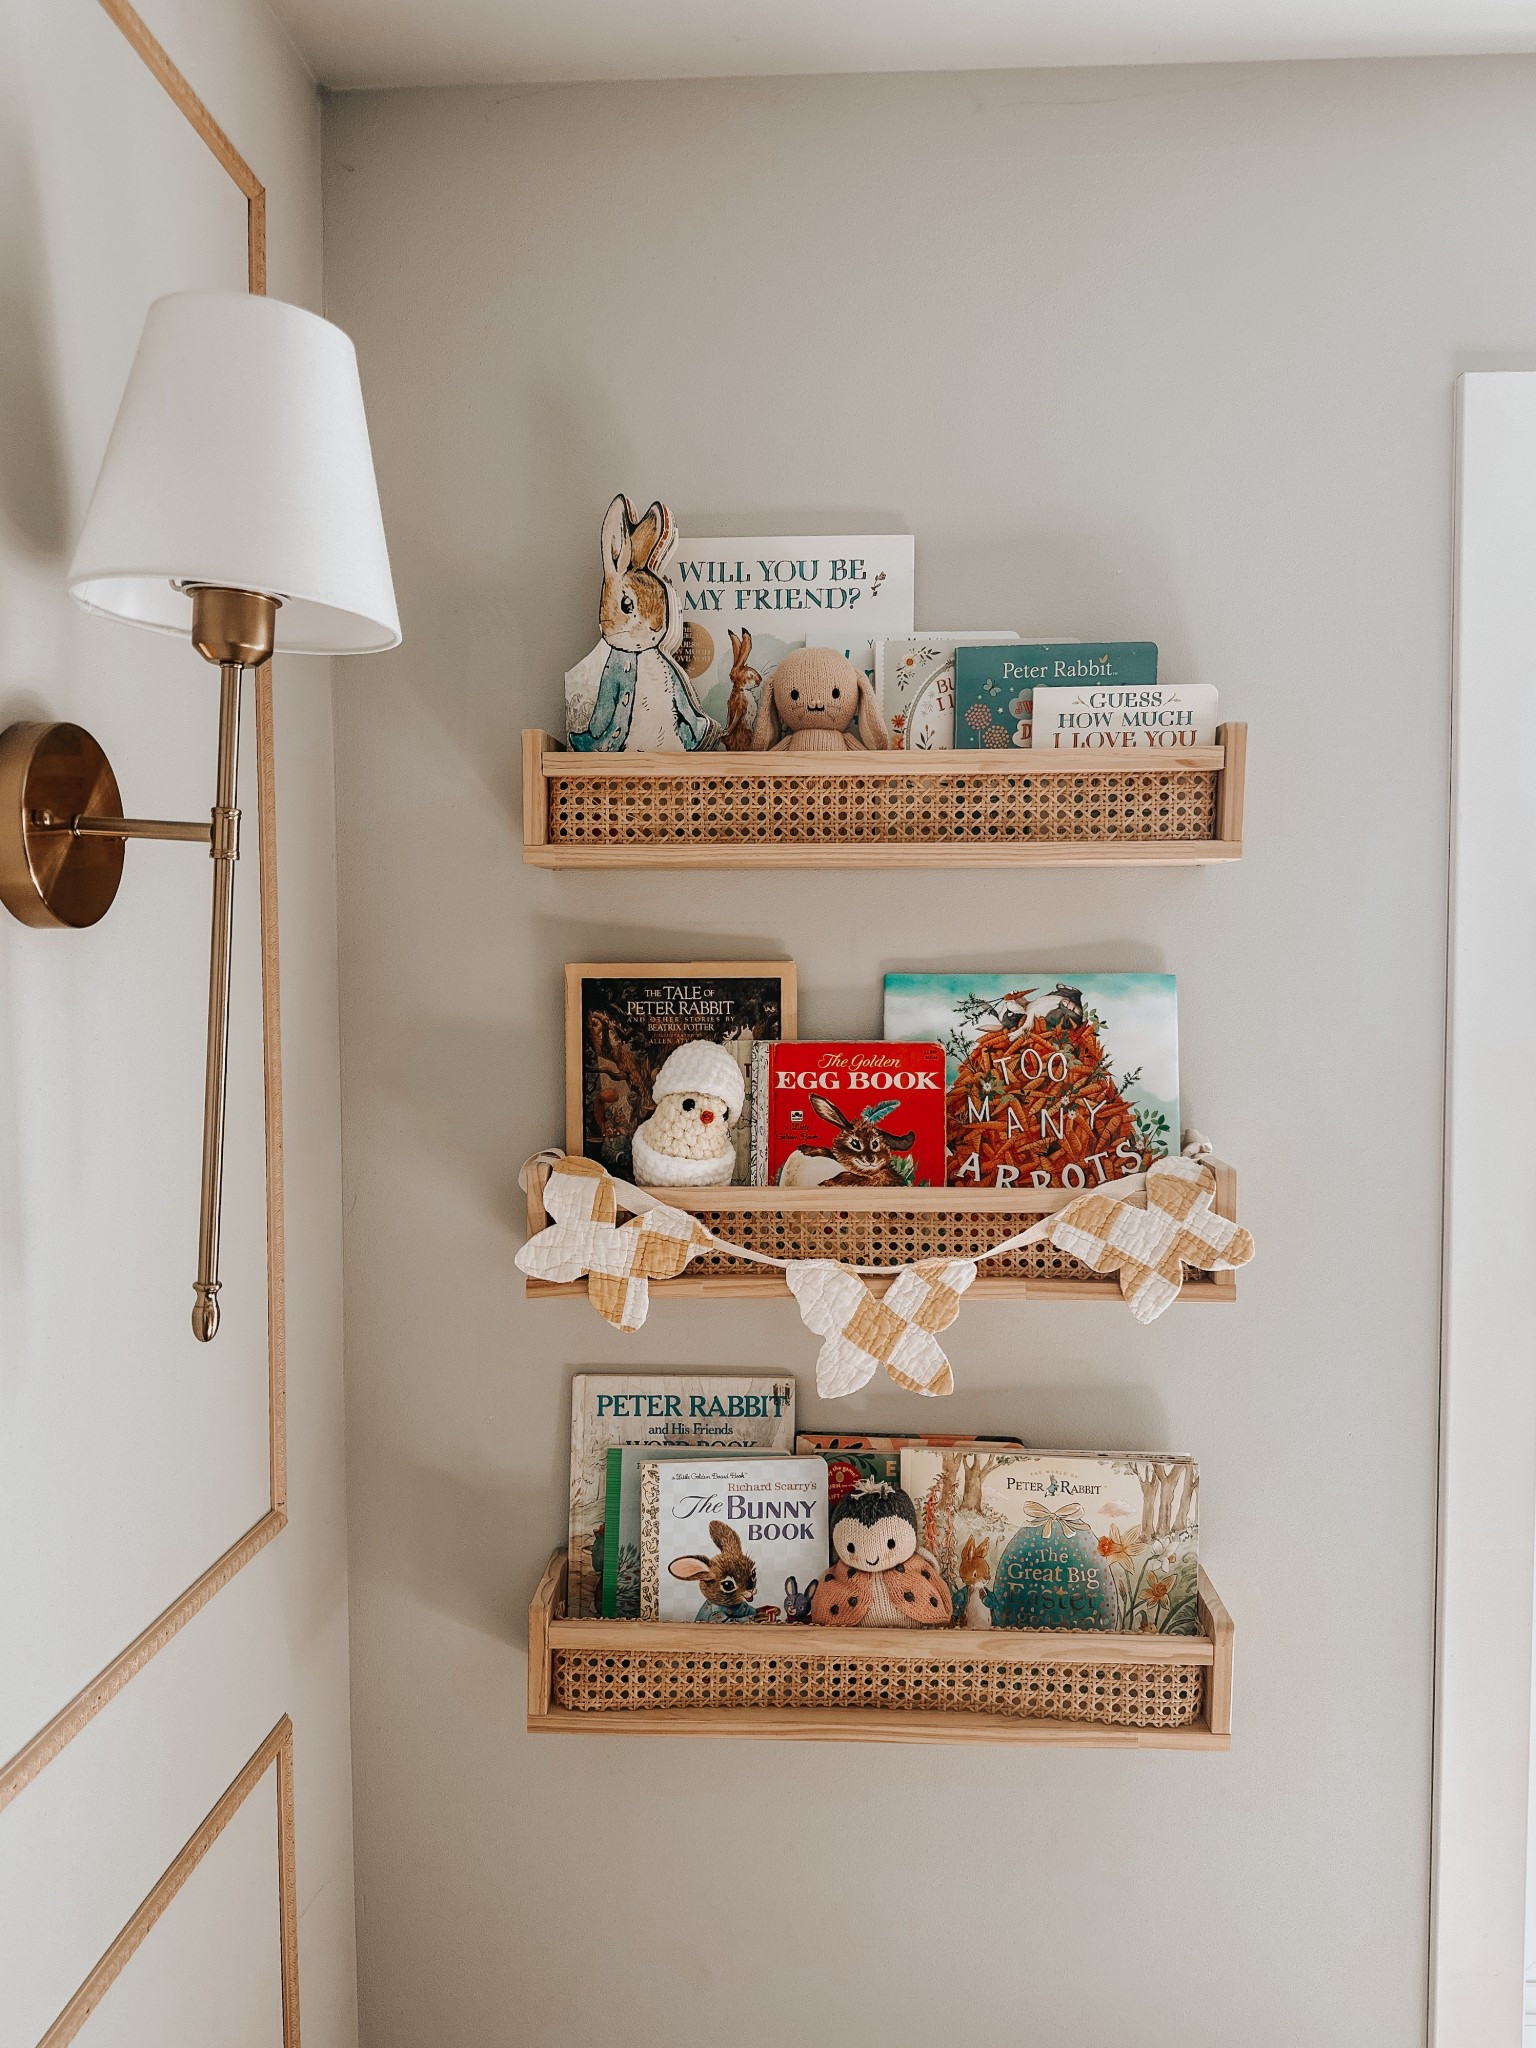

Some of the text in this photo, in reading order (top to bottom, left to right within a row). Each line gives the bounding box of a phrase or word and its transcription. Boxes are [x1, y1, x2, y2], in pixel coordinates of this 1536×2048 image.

[677, 559, 866, 584] WILL YOU BE
[683, 588, 861, 611] MY FRIEND?
[1003, 659, 1112, 679] Peter Rabbit
[1089, 692, 1163, 709] GUESS
[1058, 710, 1193, 729] HOW MUCH
[1053, 730, 1197, 748] I LOVE YOU
[645, 986, 716, 1000] THE TALE OF
[627, 1000, 735, 1015] PETER RABBIT
[648, 1023, 714, 1031] BEATRIX POTTER
[817, 1053, 902, 1071] The Golden
[993, 1048, 1068, 1085] TOO
[775, 1071, 942, 1090] EGG BOOK
[967, 1096, 1107, 1140] MANY
[947, 1140, 1143, 1188] ARROTS
[597, 1395, 787, 1418] PETER RABBIT
[648, 1423, 733, 1435] and His Friends
[727, 1481, 817, 1492] Richard Scarry's
[1006, 1477, 1102, 1495] PETER RABBIT
[671, 1494, 817, 1520] The BUNNY
[748, 1523, 815, 1541] BOOK
[1035, 1546, 1069, 1564] The
[1007, 1563, 1100, 1589] Great Big
[1007, 1582, 1099, 1611] Easter
